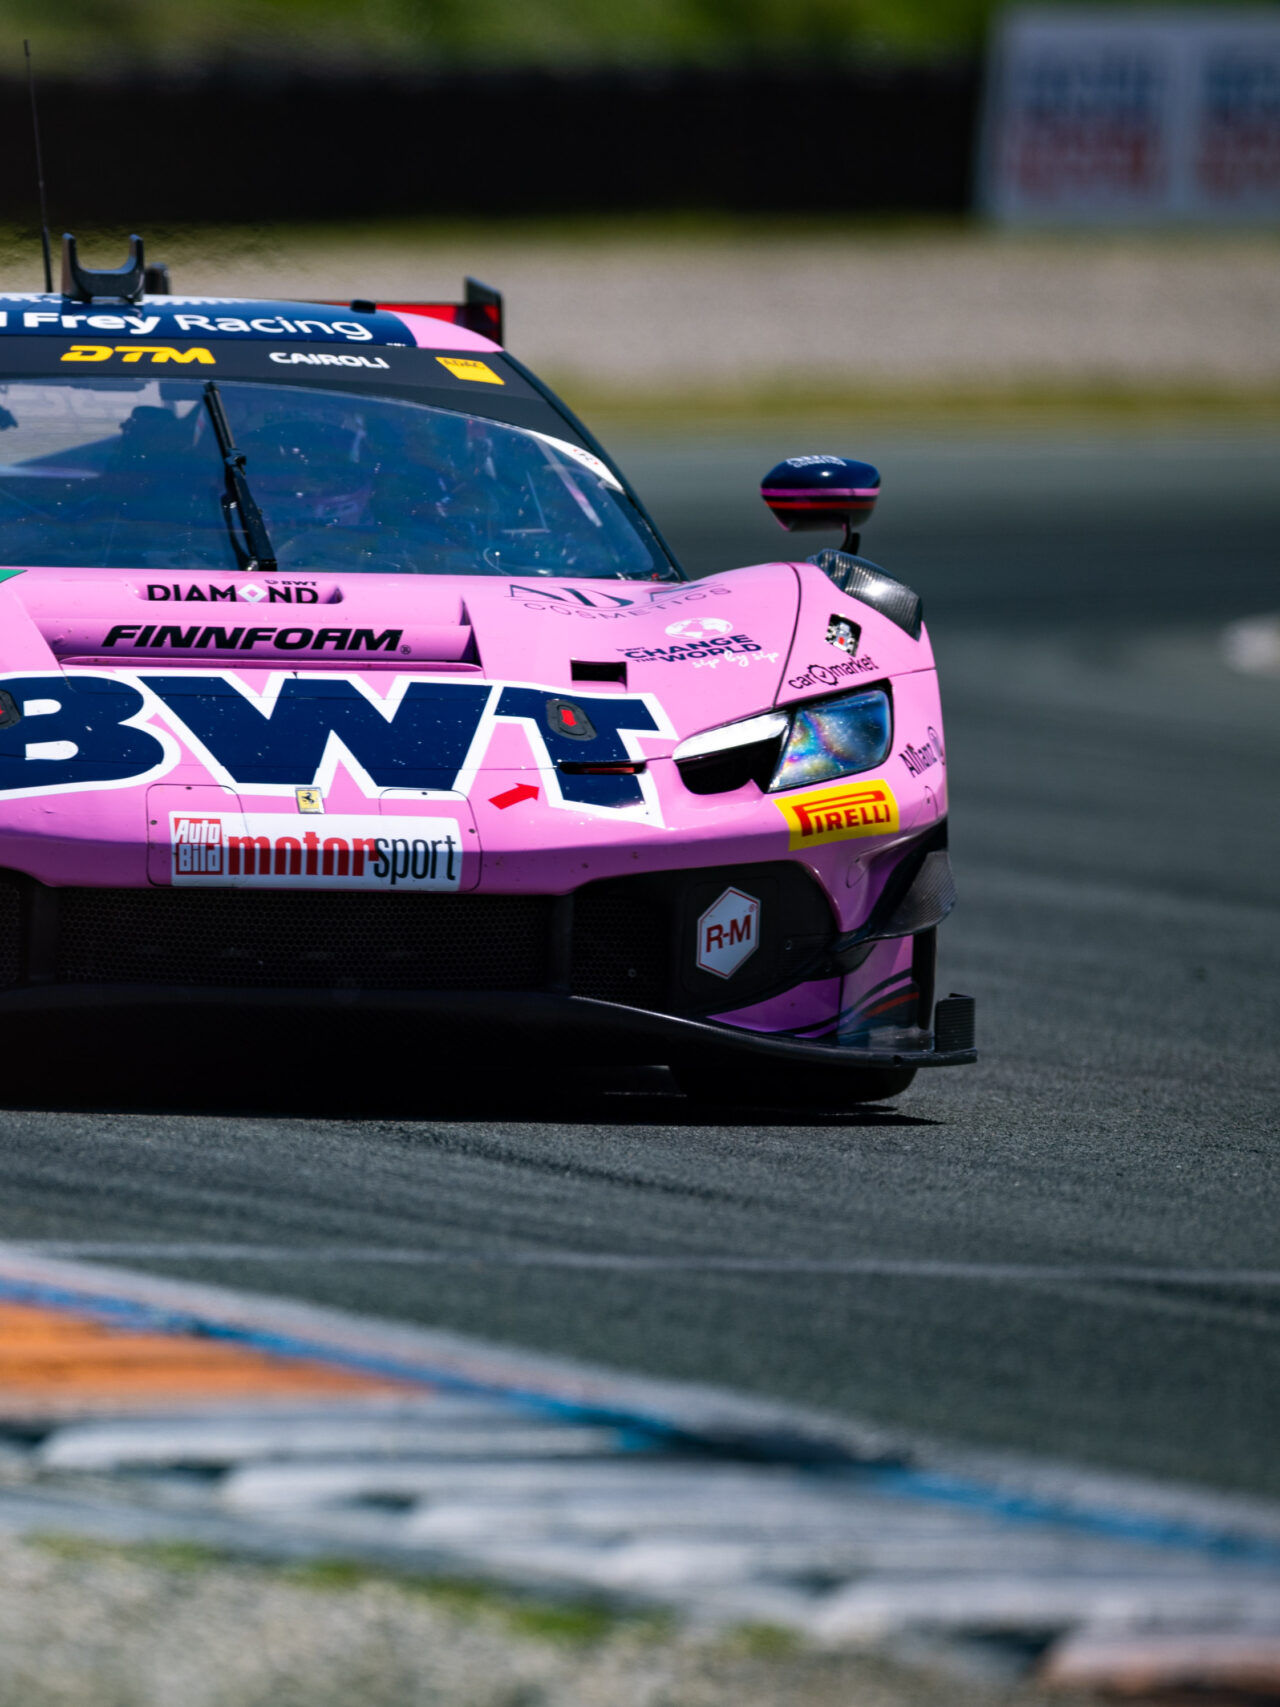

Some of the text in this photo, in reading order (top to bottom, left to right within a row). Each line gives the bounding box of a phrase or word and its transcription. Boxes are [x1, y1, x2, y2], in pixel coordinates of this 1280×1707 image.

[22, 312, 161, 334] Frey
[173, 313, 373, 341] Racing
[60, 345, 216, 364] DTM
[269, 352, 390, 369] CAIROLI
[523, 587, 731, 619] COSMETICS
[101, 624, 403, 651] FINNFOAM
[625, 634, 754, 659] CHANGE
[659, 644, 762, 662] WORLD
[791, 790, 891, 838] PIRELLI
[176, 819, 221, 843] Auto
[179, 843, 221, 872] Bild
[706, 914, 752, 953] R-M
